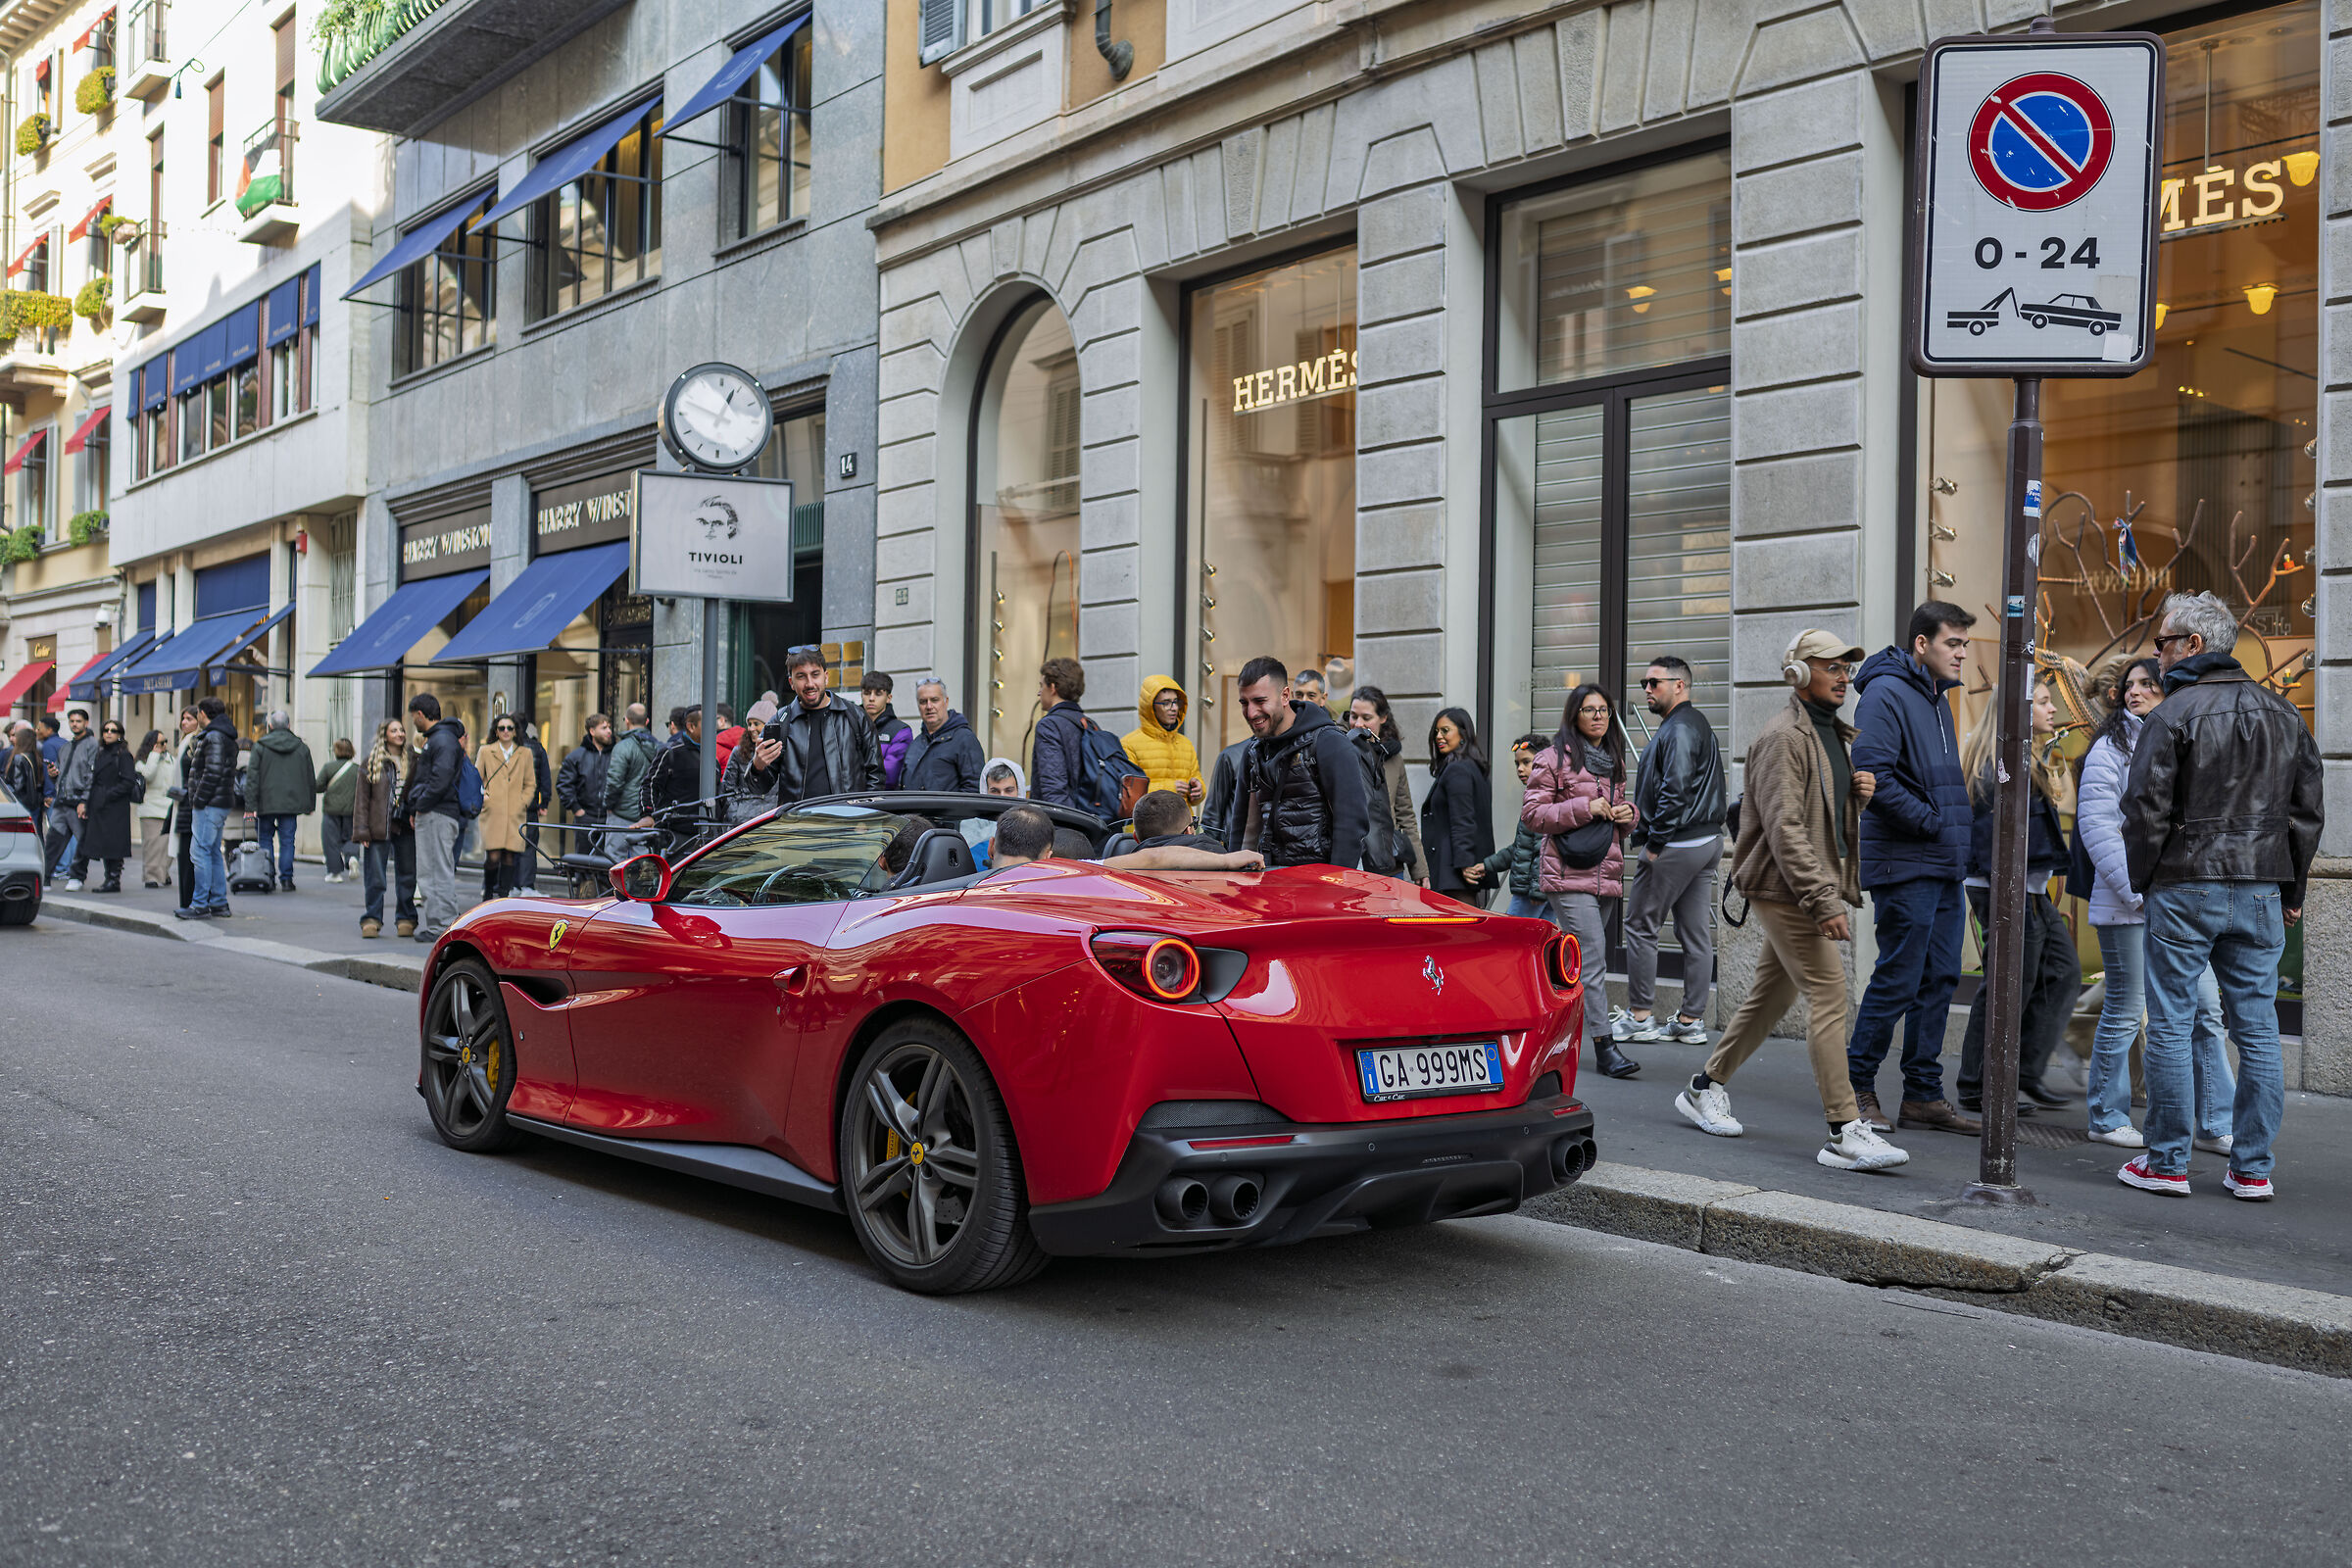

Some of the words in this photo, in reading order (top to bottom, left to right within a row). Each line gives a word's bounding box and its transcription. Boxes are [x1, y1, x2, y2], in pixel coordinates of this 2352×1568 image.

[1975, 236, 2003, 270] 0
[2040, 236, 2101, 270] 24
[840, 454, 853, 474] 14
[537, 501, 583, 535] HARRY
[403, 534, 439, 564] HARRY
[688, 552, 743, 564] TIVIOLI
[1379, 1053, 1410, 1087] GA
[1416, 1048, 1487, 1086] 999MS
